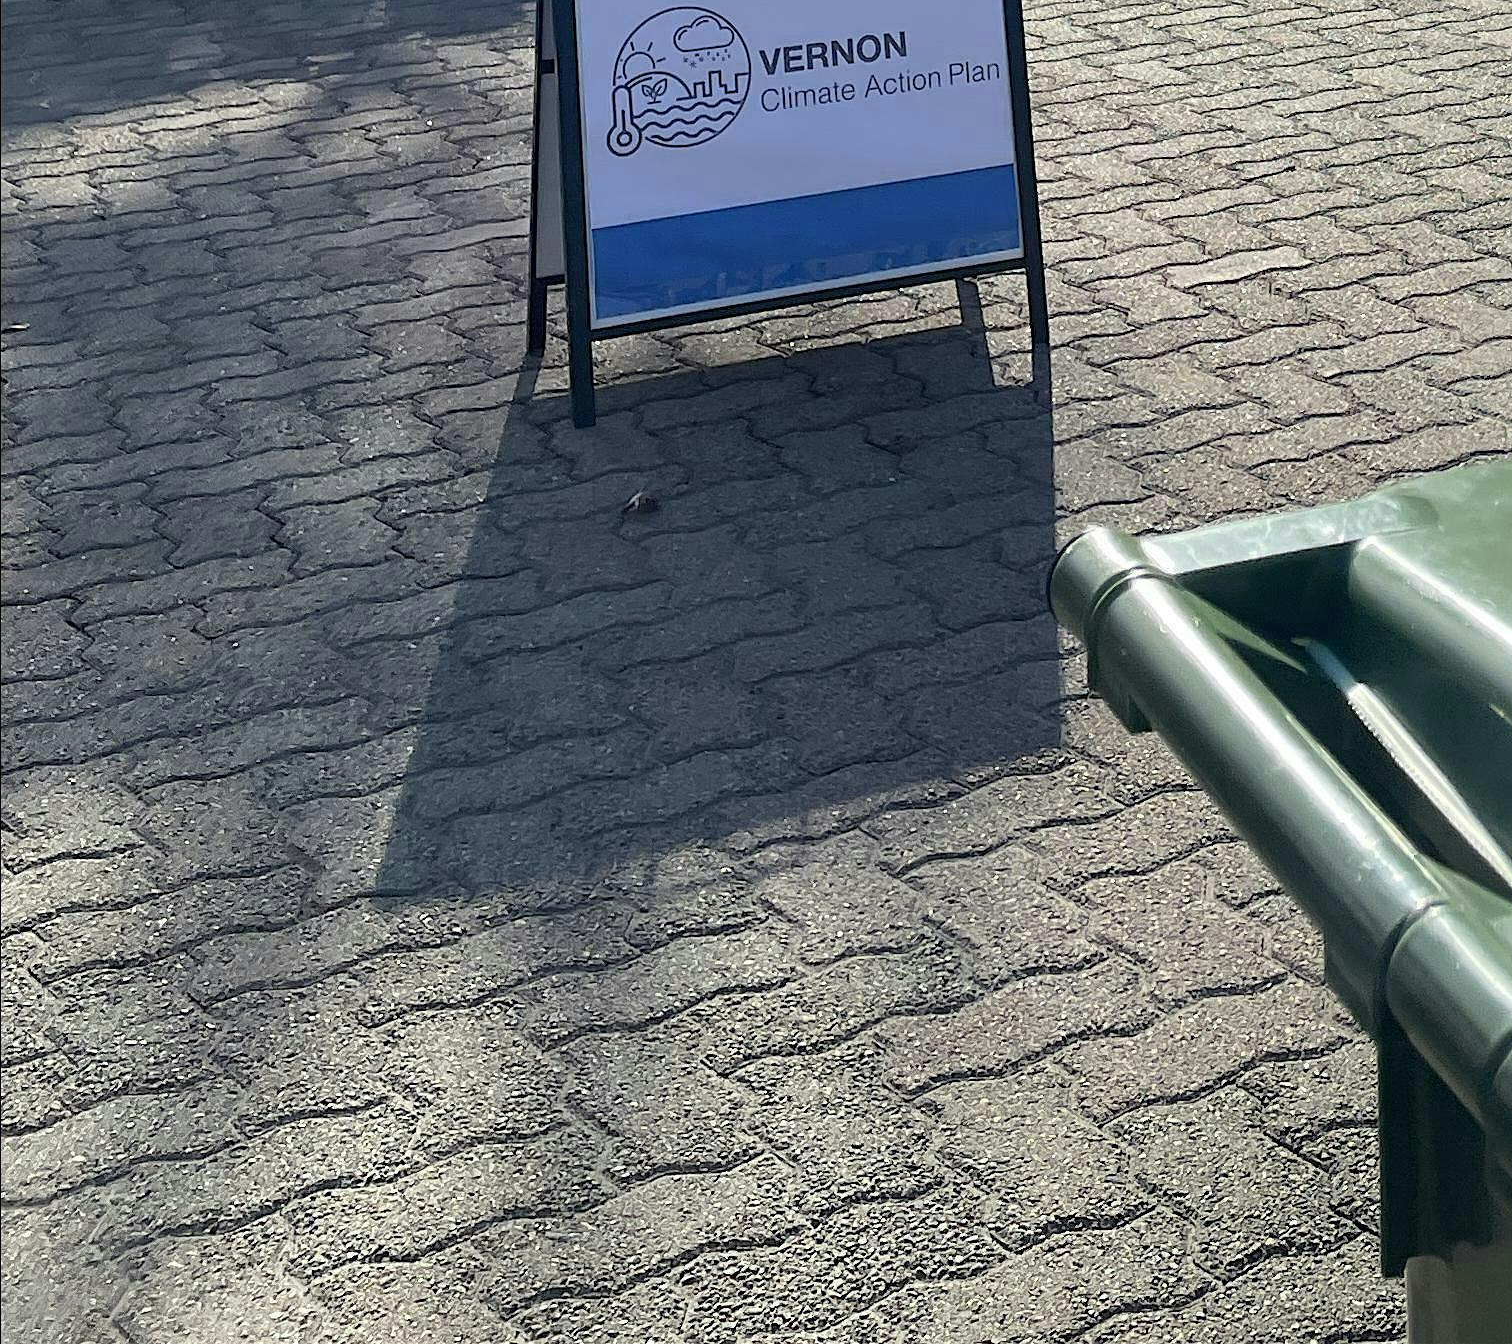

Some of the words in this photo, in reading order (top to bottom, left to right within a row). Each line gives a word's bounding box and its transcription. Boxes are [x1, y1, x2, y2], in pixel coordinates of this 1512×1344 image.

[759, 31, 907, 75] VERNON
[761, 82, 855, 112] Climate
[865, 69, 941, 98] Action
[949, 61, 1000, 86] Plan
